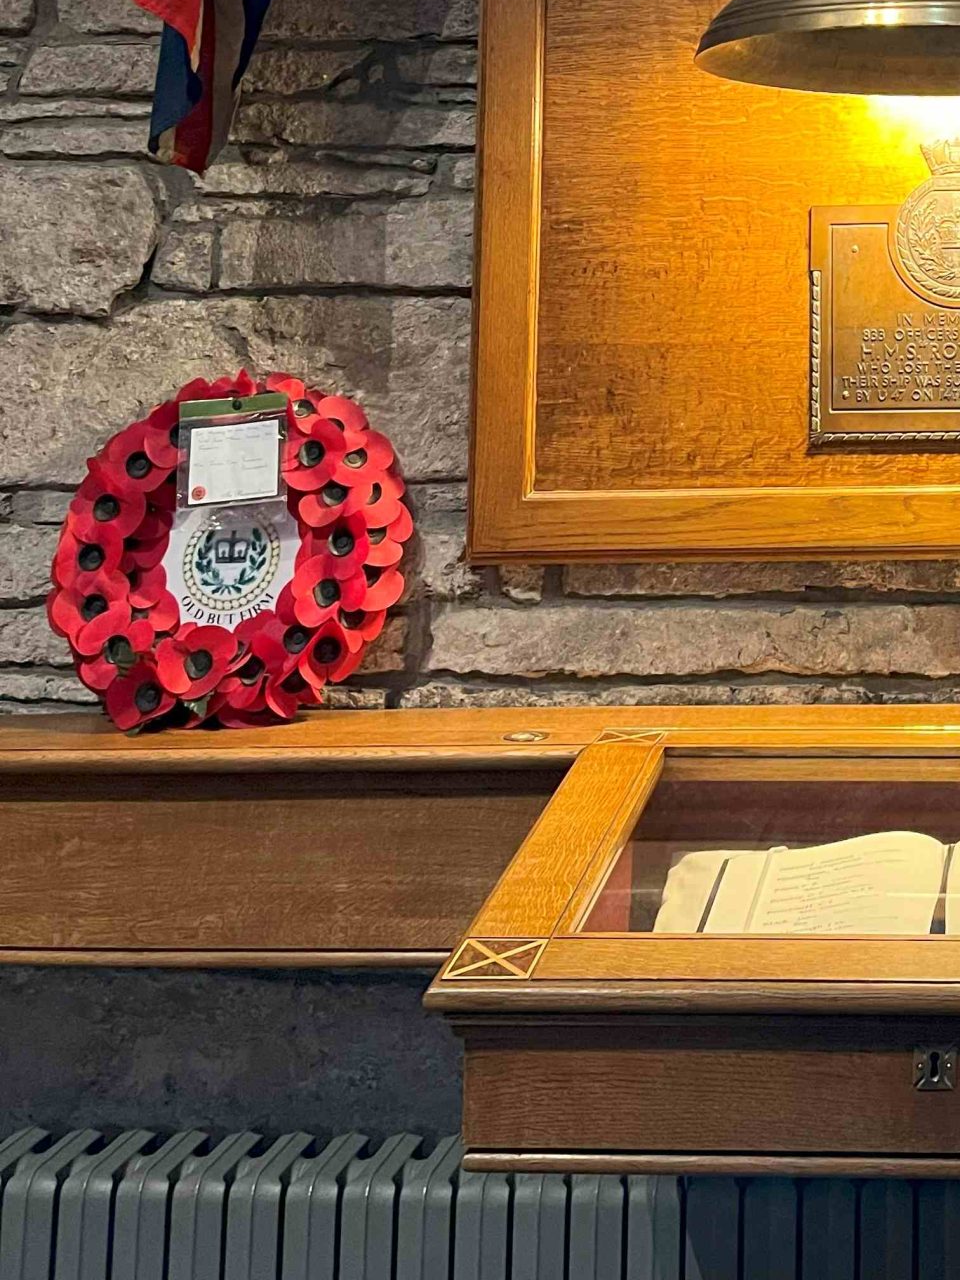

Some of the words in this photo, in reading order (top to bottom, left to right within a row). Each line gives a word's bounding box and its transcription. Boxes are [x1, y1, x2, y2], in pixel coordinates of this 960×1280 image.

[896, 312, 913, 327] IN
[894, 327, 959, 341] OFFICERS
[856, 361, 892, 375] WHO
[898, 361, 930, 374] LOST
[841, 375, 879, 389] THEIR
[881, 375, 911, 389] SHIP
[914, 375, 942, 389] WAS
[856, 389, 871, 403] BY
[911, 388, 934, 402] ON
[181, 595, 205, 620] OLD
[206, 612, 235, 626] BUT
